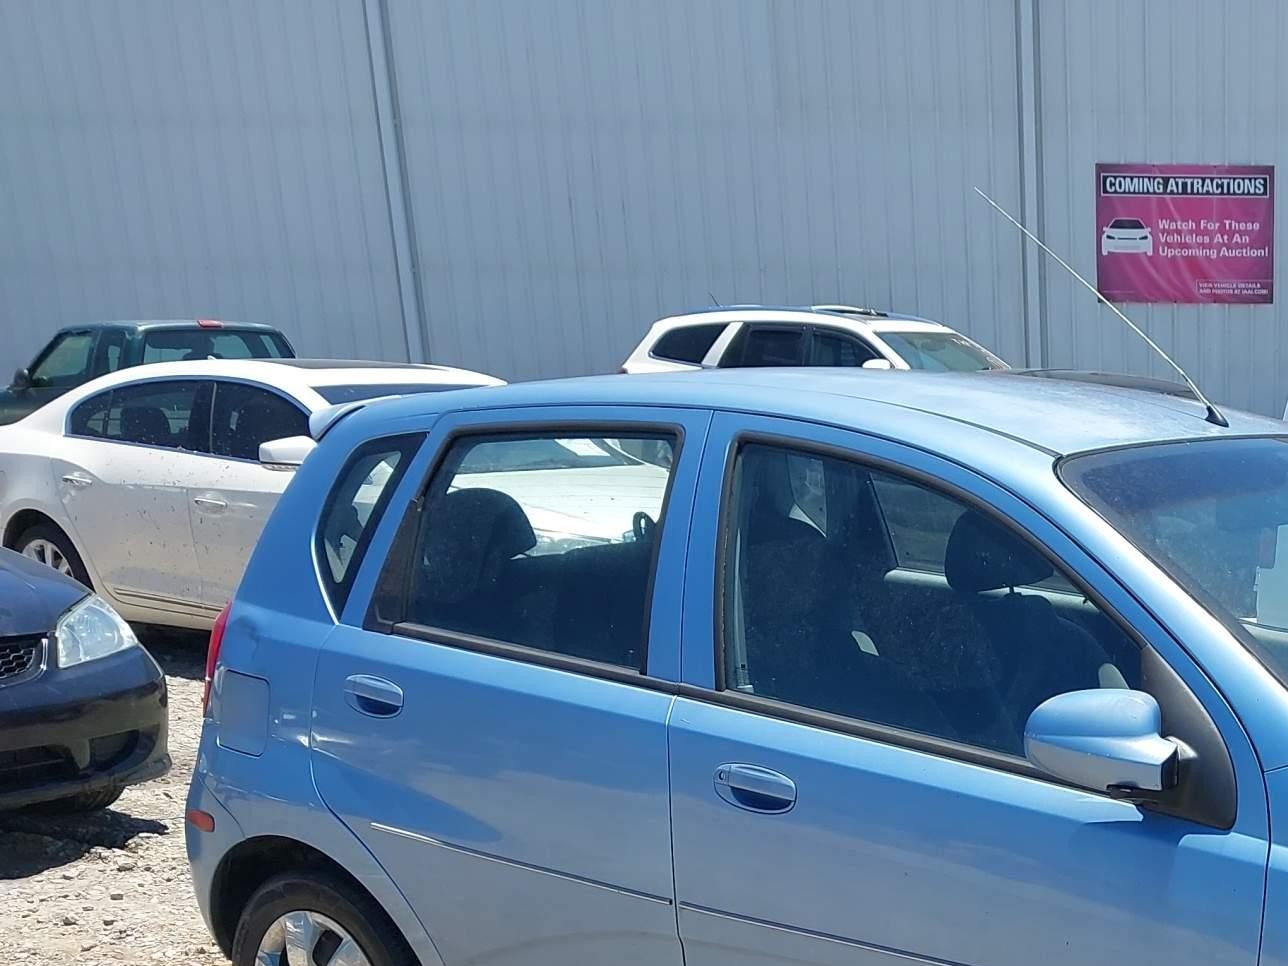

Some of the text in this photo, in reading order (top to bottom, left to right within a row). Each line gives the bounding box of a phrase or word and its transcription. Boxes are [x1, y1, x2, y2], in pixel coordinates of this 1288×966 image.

[1106, 177, 1265, 194] COMING ATTRACTIONS
[1158, 219, 1260, 230] Watch For These
[1159, 234, 1249, 243] Vehicles At An
[1159, 247, 1269, 259] Upcoming Auction!
